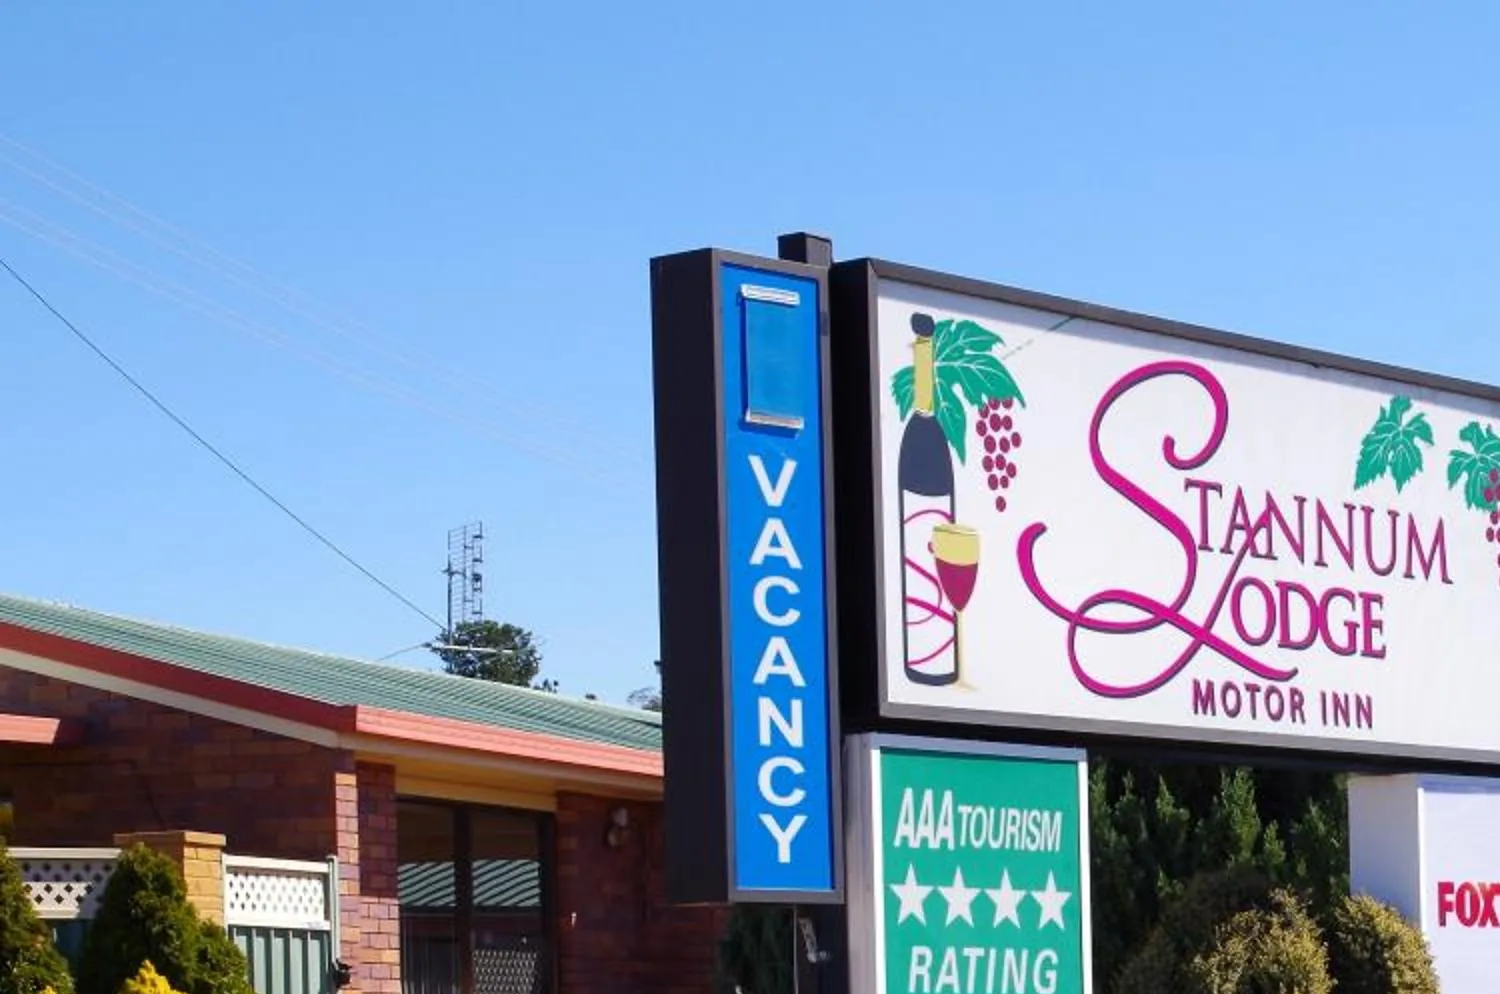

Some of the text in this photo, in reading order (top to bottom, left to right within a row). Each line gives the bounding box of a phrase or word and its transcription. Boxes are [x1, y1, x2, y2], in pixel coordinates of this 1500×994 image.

[749, 455, 807, 863] VACANCY
[1192, 678, 1373, 730] MOTOR INN
[893, 787, 1063, 852] AAA TOURISM
